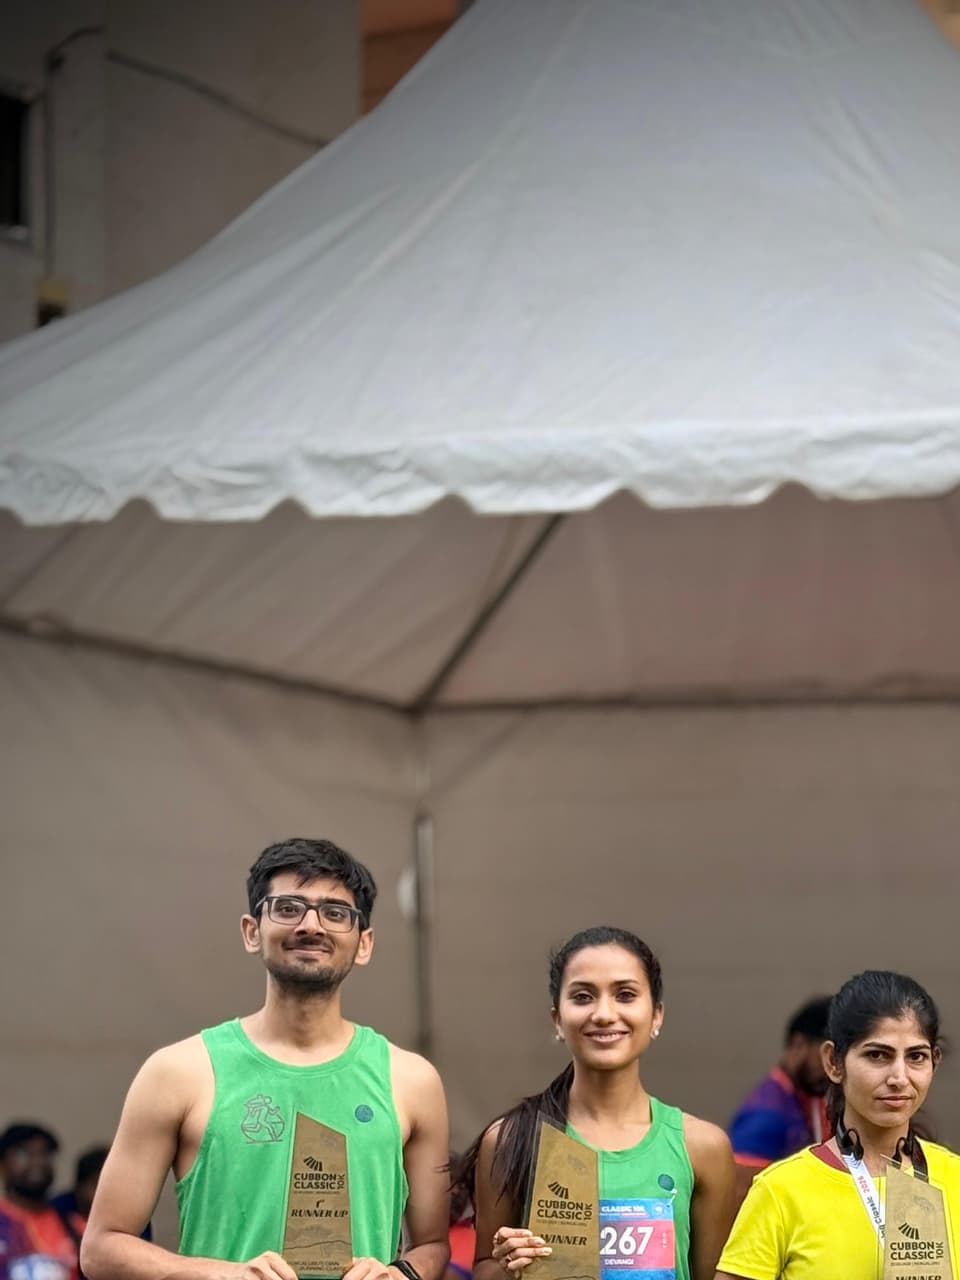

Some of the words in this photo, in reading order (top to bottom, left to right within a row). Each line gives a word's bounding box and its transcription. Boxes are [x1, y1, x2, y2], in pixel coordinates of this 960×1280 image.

[294, 1172, 337, 1181] CUBBON
[294, 1181, 336, 1190] CLASSIC
[537, 1199, 584, 1211] CUBBON
[291, 1209, 333, 1218] RUNNER
[334, 1210, 349, 1218] UP
[536, 1209, 583, 1221] CLASSIC
[583, 1203, 593, 1221] 10K
[540, 1233, 588, 1246] WINNER
[600, 1226, 654, 1255] 267
[890, 1241, 935, 1251] CUBBON
[935, 1241, 945, 1259] 10K
[890, 1251, 935, 1261] CLASSIC
